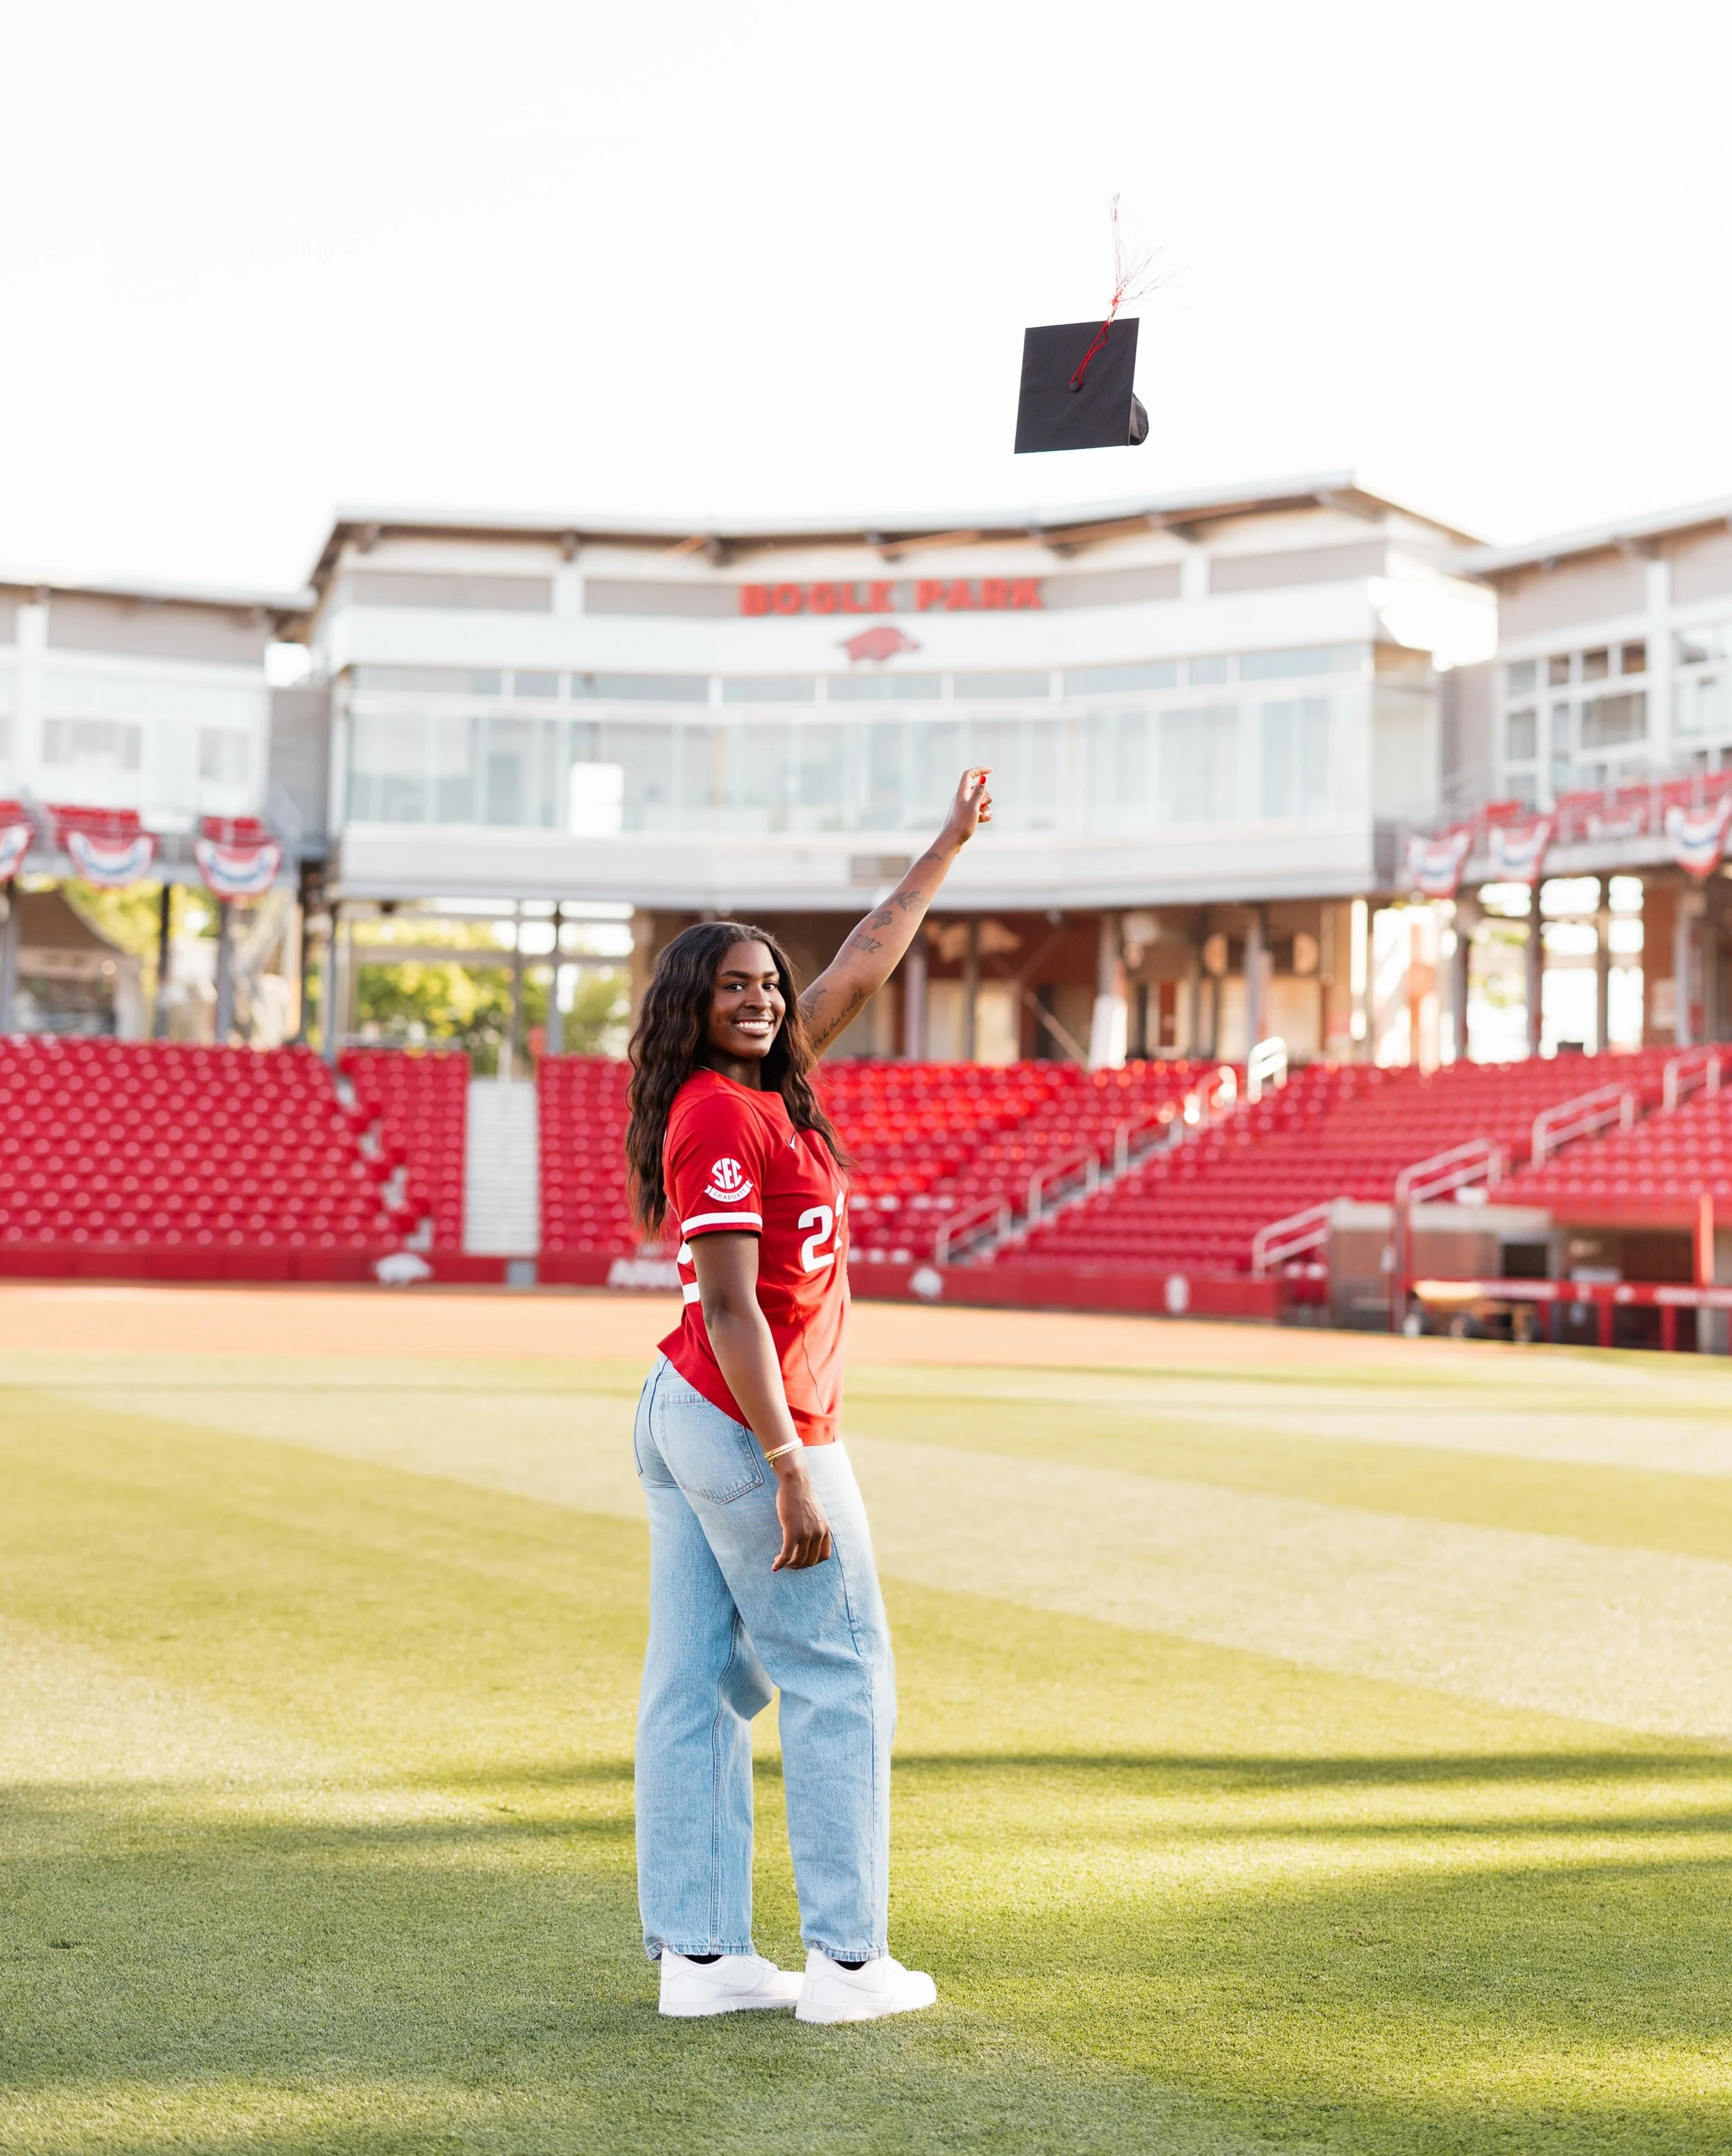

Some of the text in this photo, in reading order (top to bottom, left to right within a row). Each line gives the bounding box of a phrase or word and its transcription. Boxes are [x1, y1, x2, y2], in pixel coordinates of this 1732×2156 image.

[740, 578, 1044, 616] BOGLE PARK
[712, 1158, 743, 1190] SEC
[713, 1187, 748, 1200] GRADUATE
